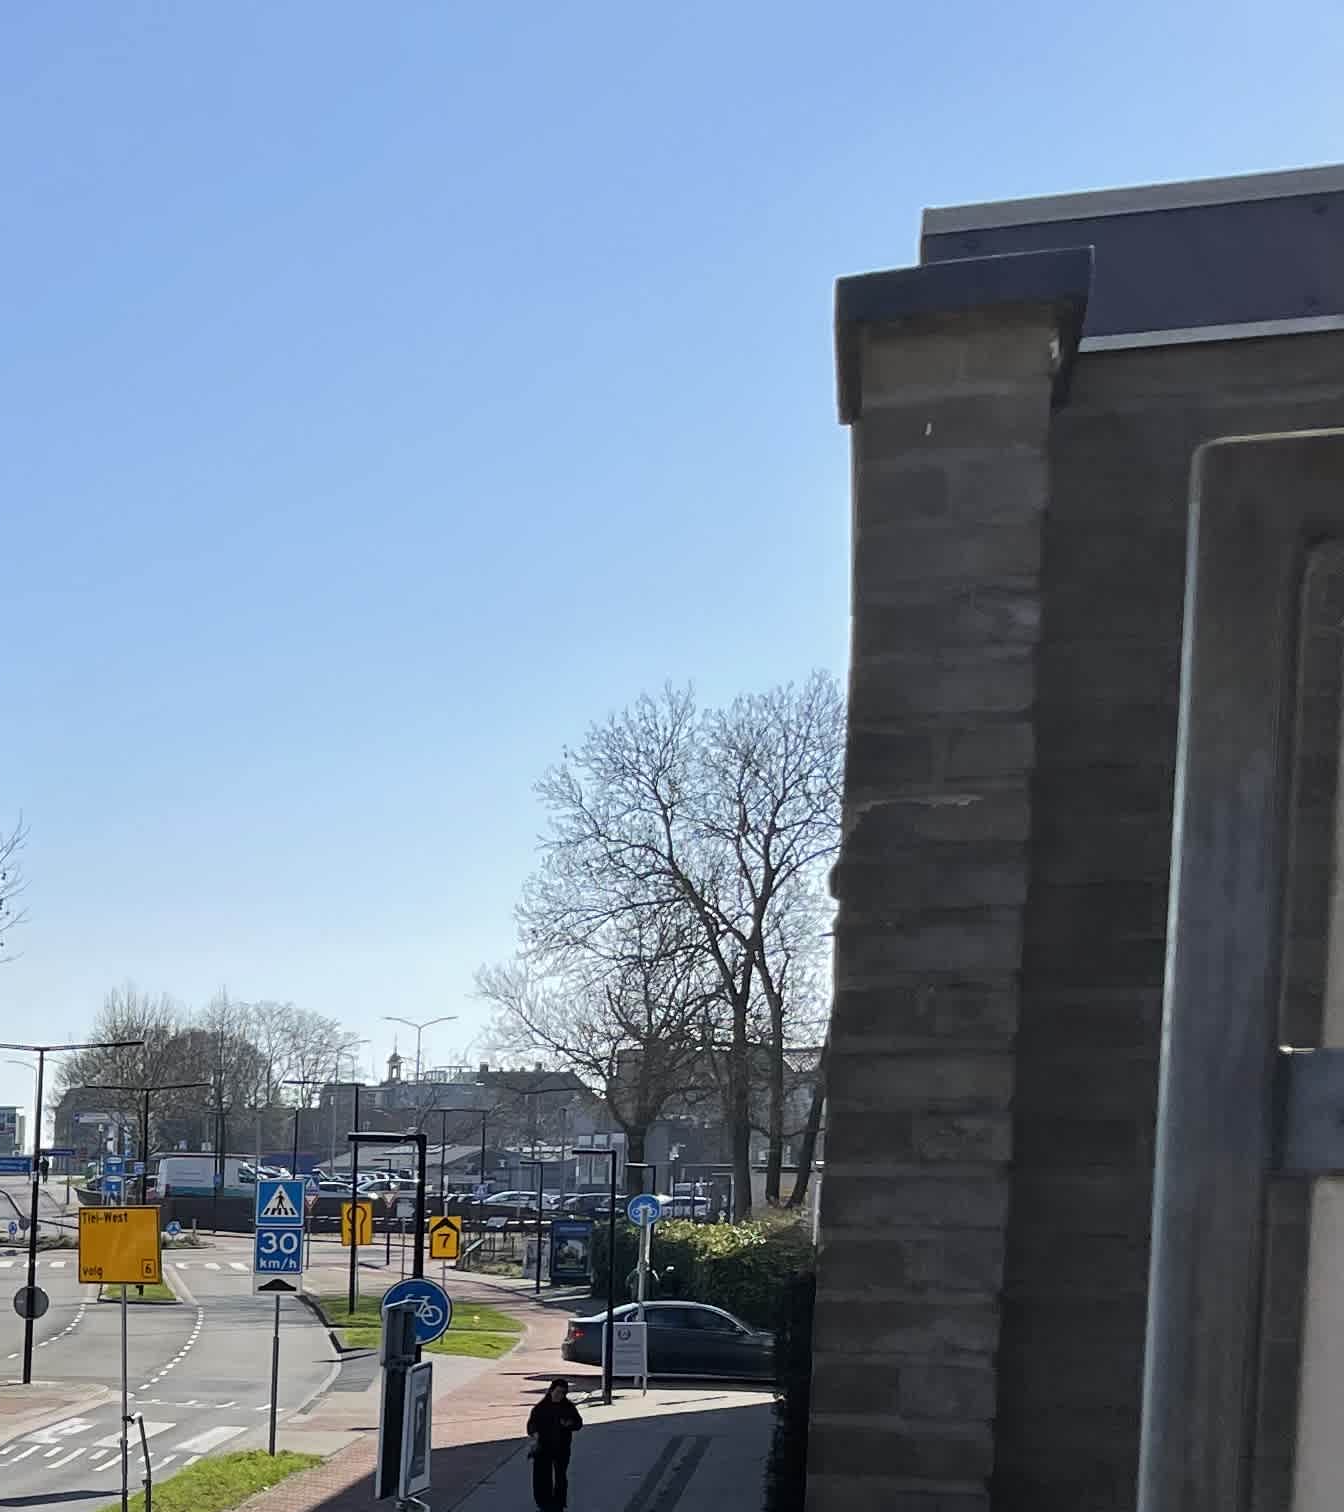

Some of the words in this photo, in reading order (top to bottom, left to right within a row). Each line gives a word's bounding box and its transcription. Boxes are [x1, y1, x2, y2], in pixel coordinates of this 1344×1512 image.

[82, 1211, 129, 1224] Tiel-West
[259, 1231, 298, 1254] 30
[437, 1233, 451, 1249] 7
[82, 1266, 104, 1280] volg
[145, 1263, 152, 1274] 6
[259, 1257, 297, 1270] km/h
